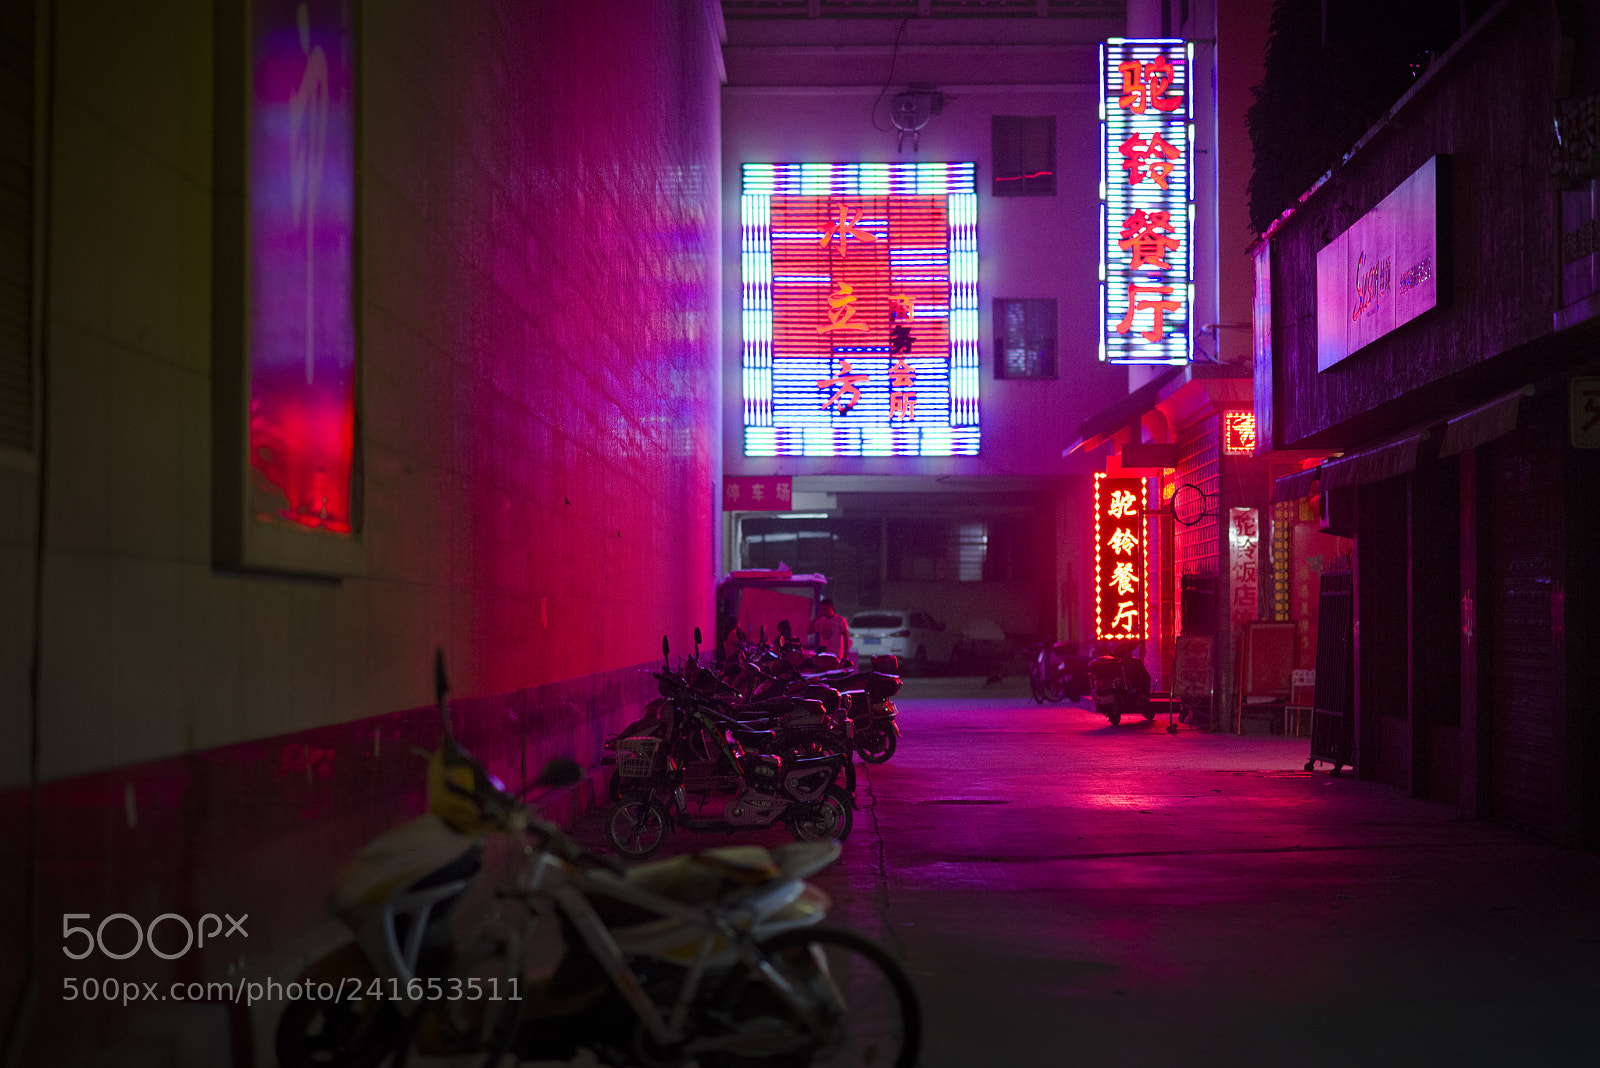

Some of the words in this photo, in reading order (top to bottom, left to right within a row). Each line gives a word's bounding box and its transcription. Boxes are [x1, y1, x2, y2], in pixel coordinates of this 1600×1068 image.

[1116, 56, 1182, 343] 驼铃餐厅
[817, 203, 878, 416] 水立方
[888, 294, 917, 421] 商务会所
[727, 483, 791, 502] 停车场
[1107, 490, 1140, 632] 驼铃餐厅
